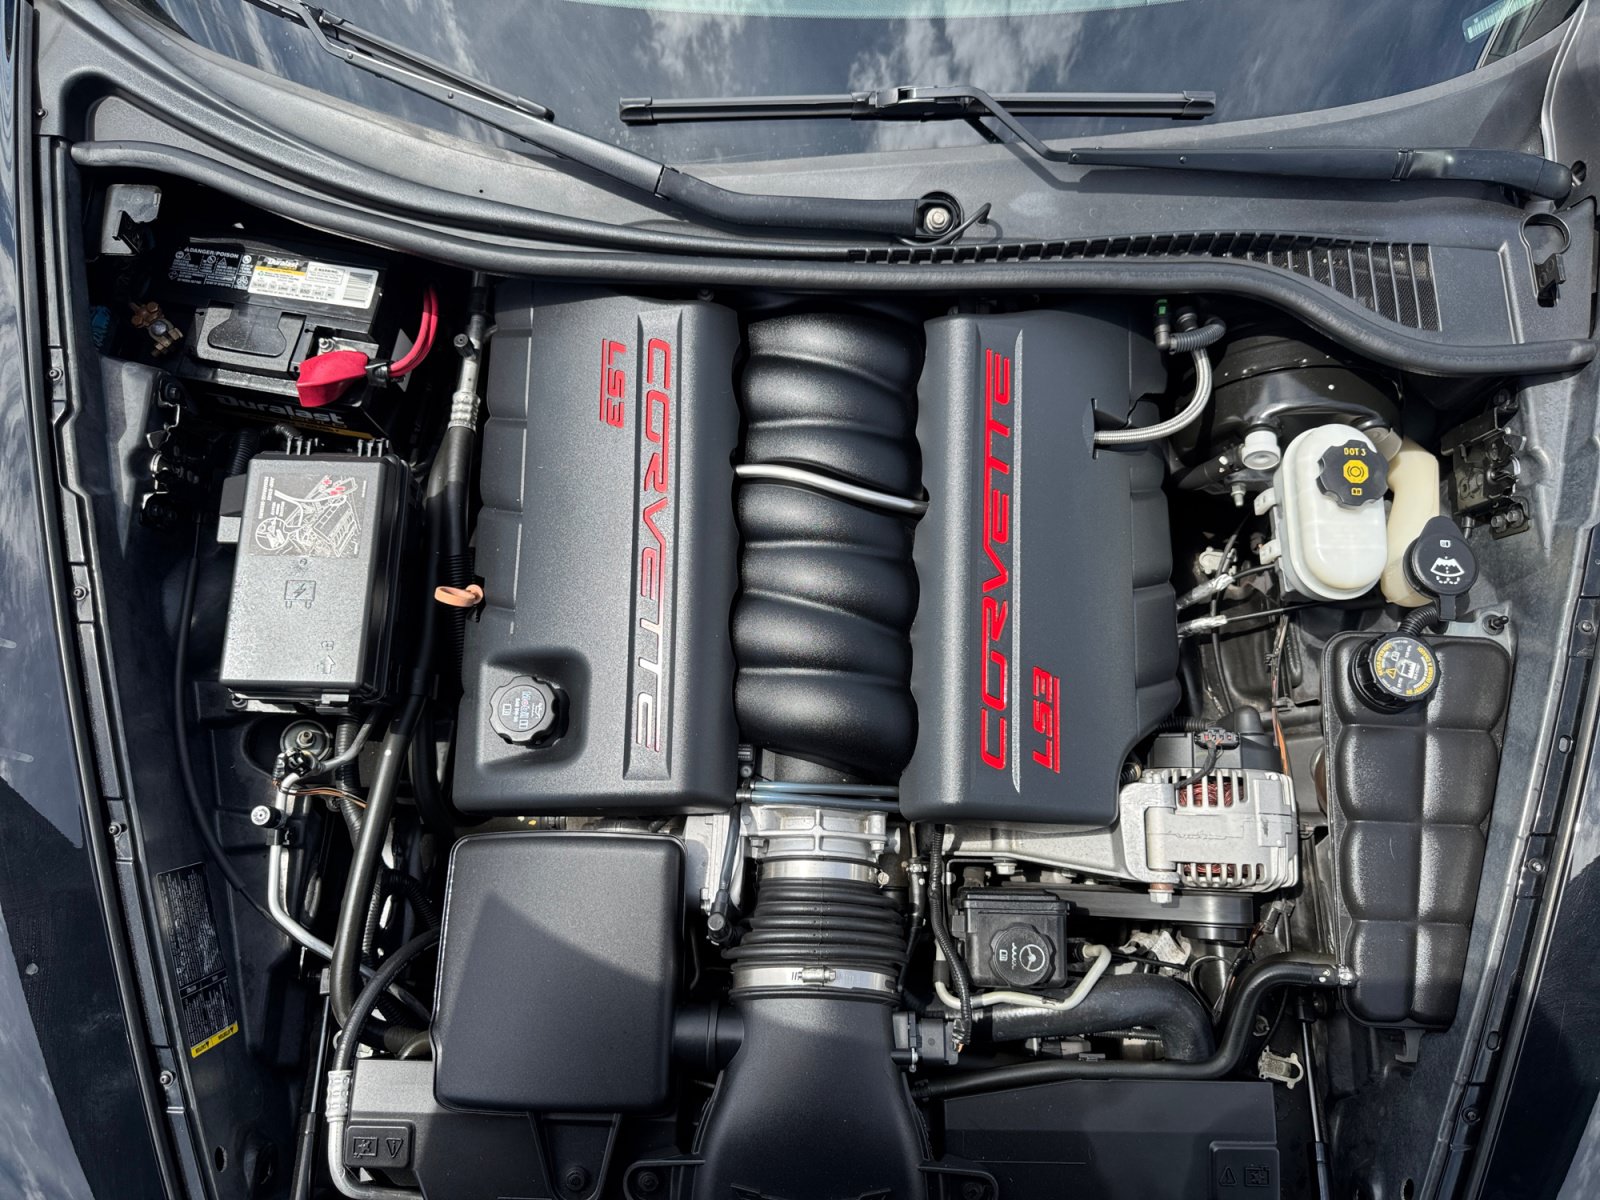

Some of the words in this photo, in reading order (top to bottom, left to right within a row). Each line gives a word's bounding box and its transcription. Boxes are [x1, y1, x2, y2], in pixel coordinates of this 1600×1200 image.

[213, 394, 345, 425] Duralast
[606, 340, 627, 429] LS3
[1343, 447, 1360, 456] DOT
[1361, 448, 1367, 457] 3
[636, 337, 672, 752] CORVETTE
[980, 348, 1011, 770] CORVETTE
[1032, 666, 1054, 770] LS3
